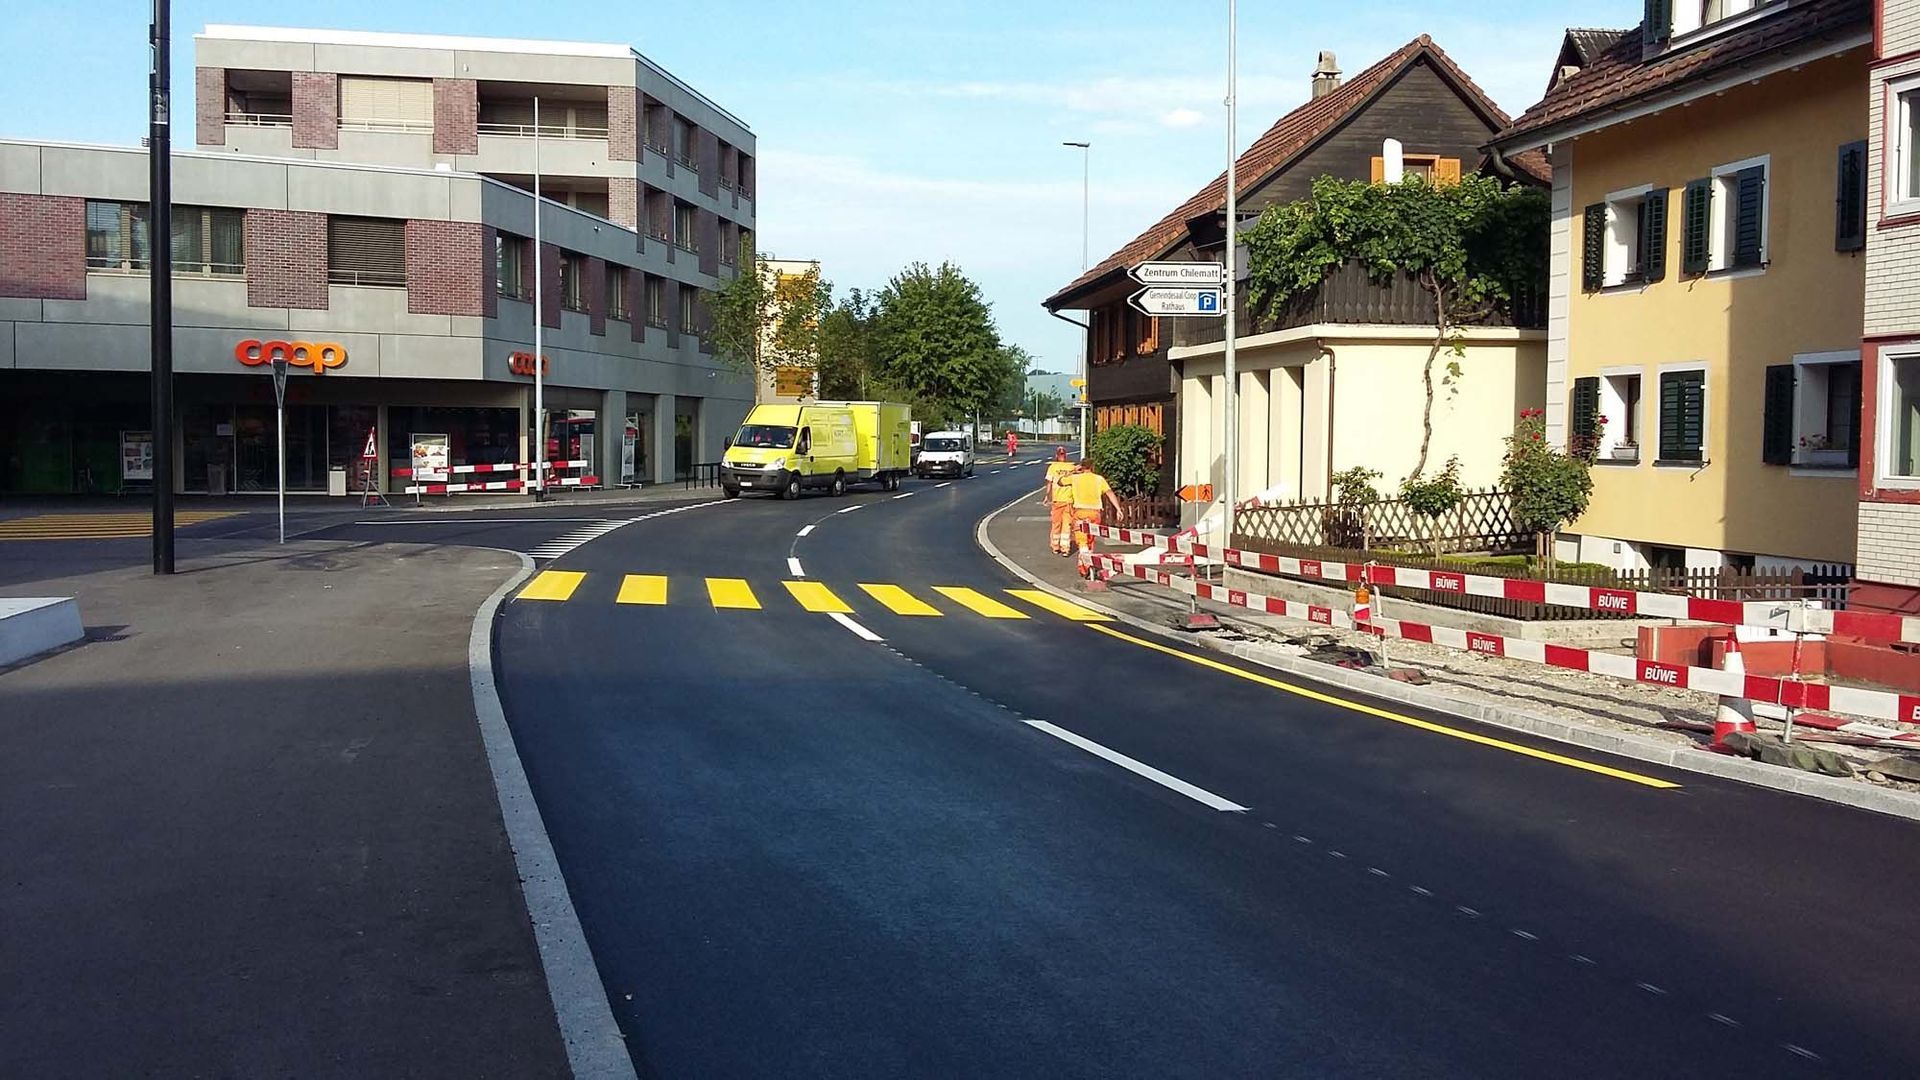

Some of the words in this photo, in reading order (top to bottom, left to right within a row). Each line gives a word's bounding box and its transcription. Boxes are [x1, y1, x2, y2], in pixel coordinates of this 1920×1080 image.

[1144, 268, 1178, 277] Zentrum
[1180, 268, 1218, 277] Chilematt
[1149, 291, 1183, 300] Gemeindesaal
[1161, 302, 1185, 311] Rathaus
[234, 338, 347, 374] coop
[1434, 577, 1460, 591] BÜWE
[1597, 592, 1628, 610] BÜWE
[1471, 636, 1497, 652] BÜWE
[1644, 666, 1677, 684] BÜWE
